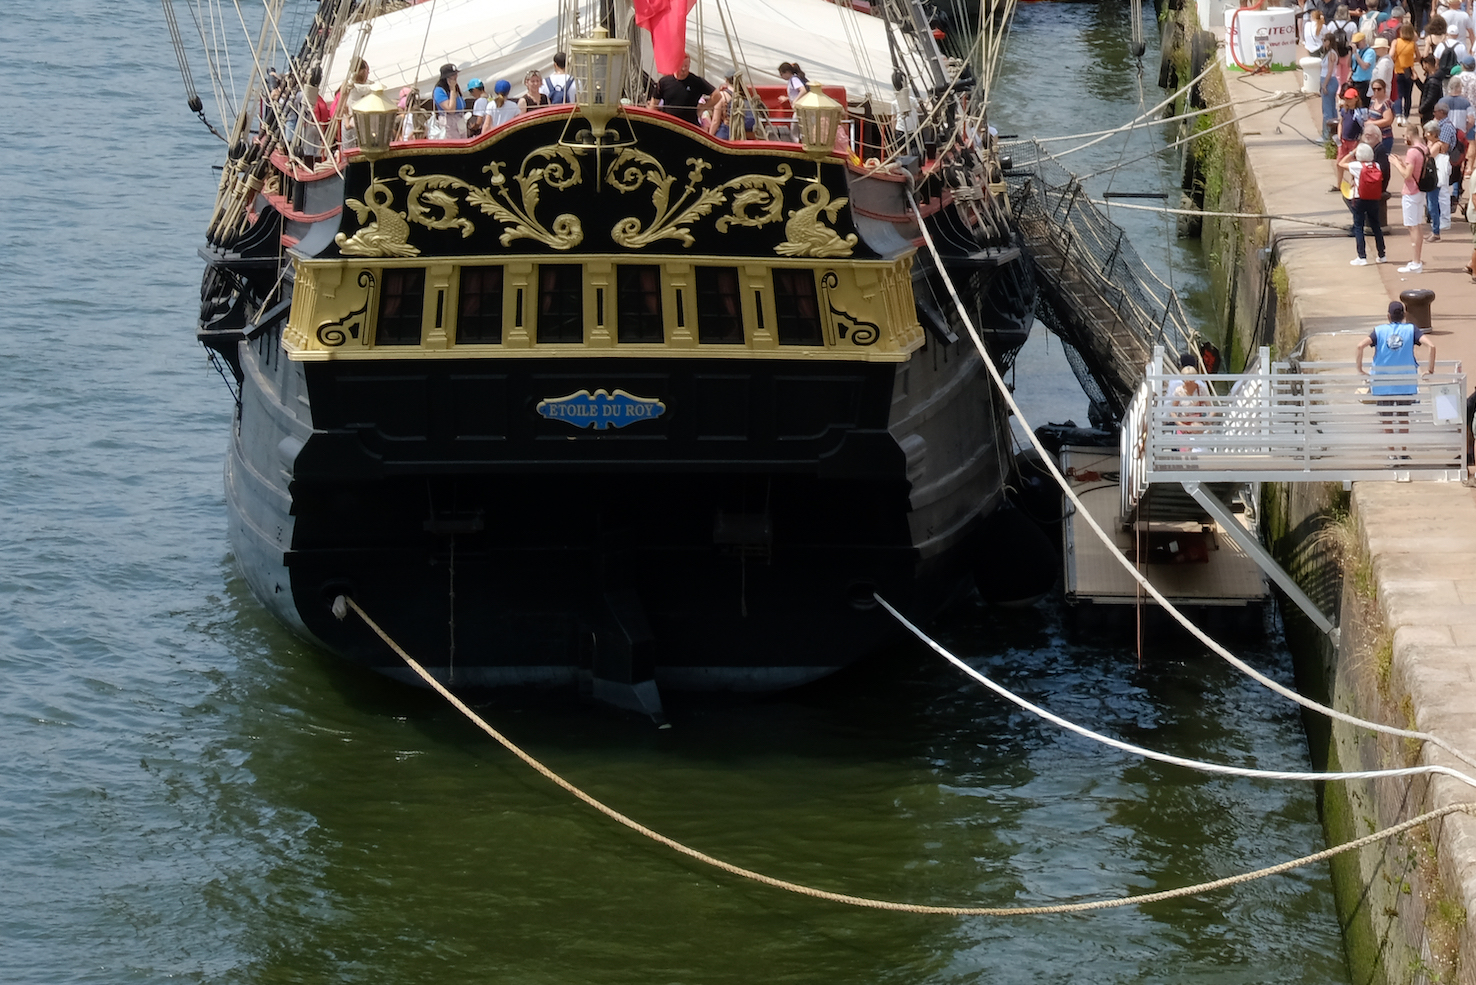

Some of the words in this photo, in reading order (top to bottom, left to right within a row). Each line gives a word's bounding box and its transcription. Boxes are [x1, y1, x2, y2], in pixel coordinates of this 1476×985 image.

[549, 404, 598, 416] ETOILE
[602, 404, 621, 416] DU
[626, 404, 654, 416] ROY
